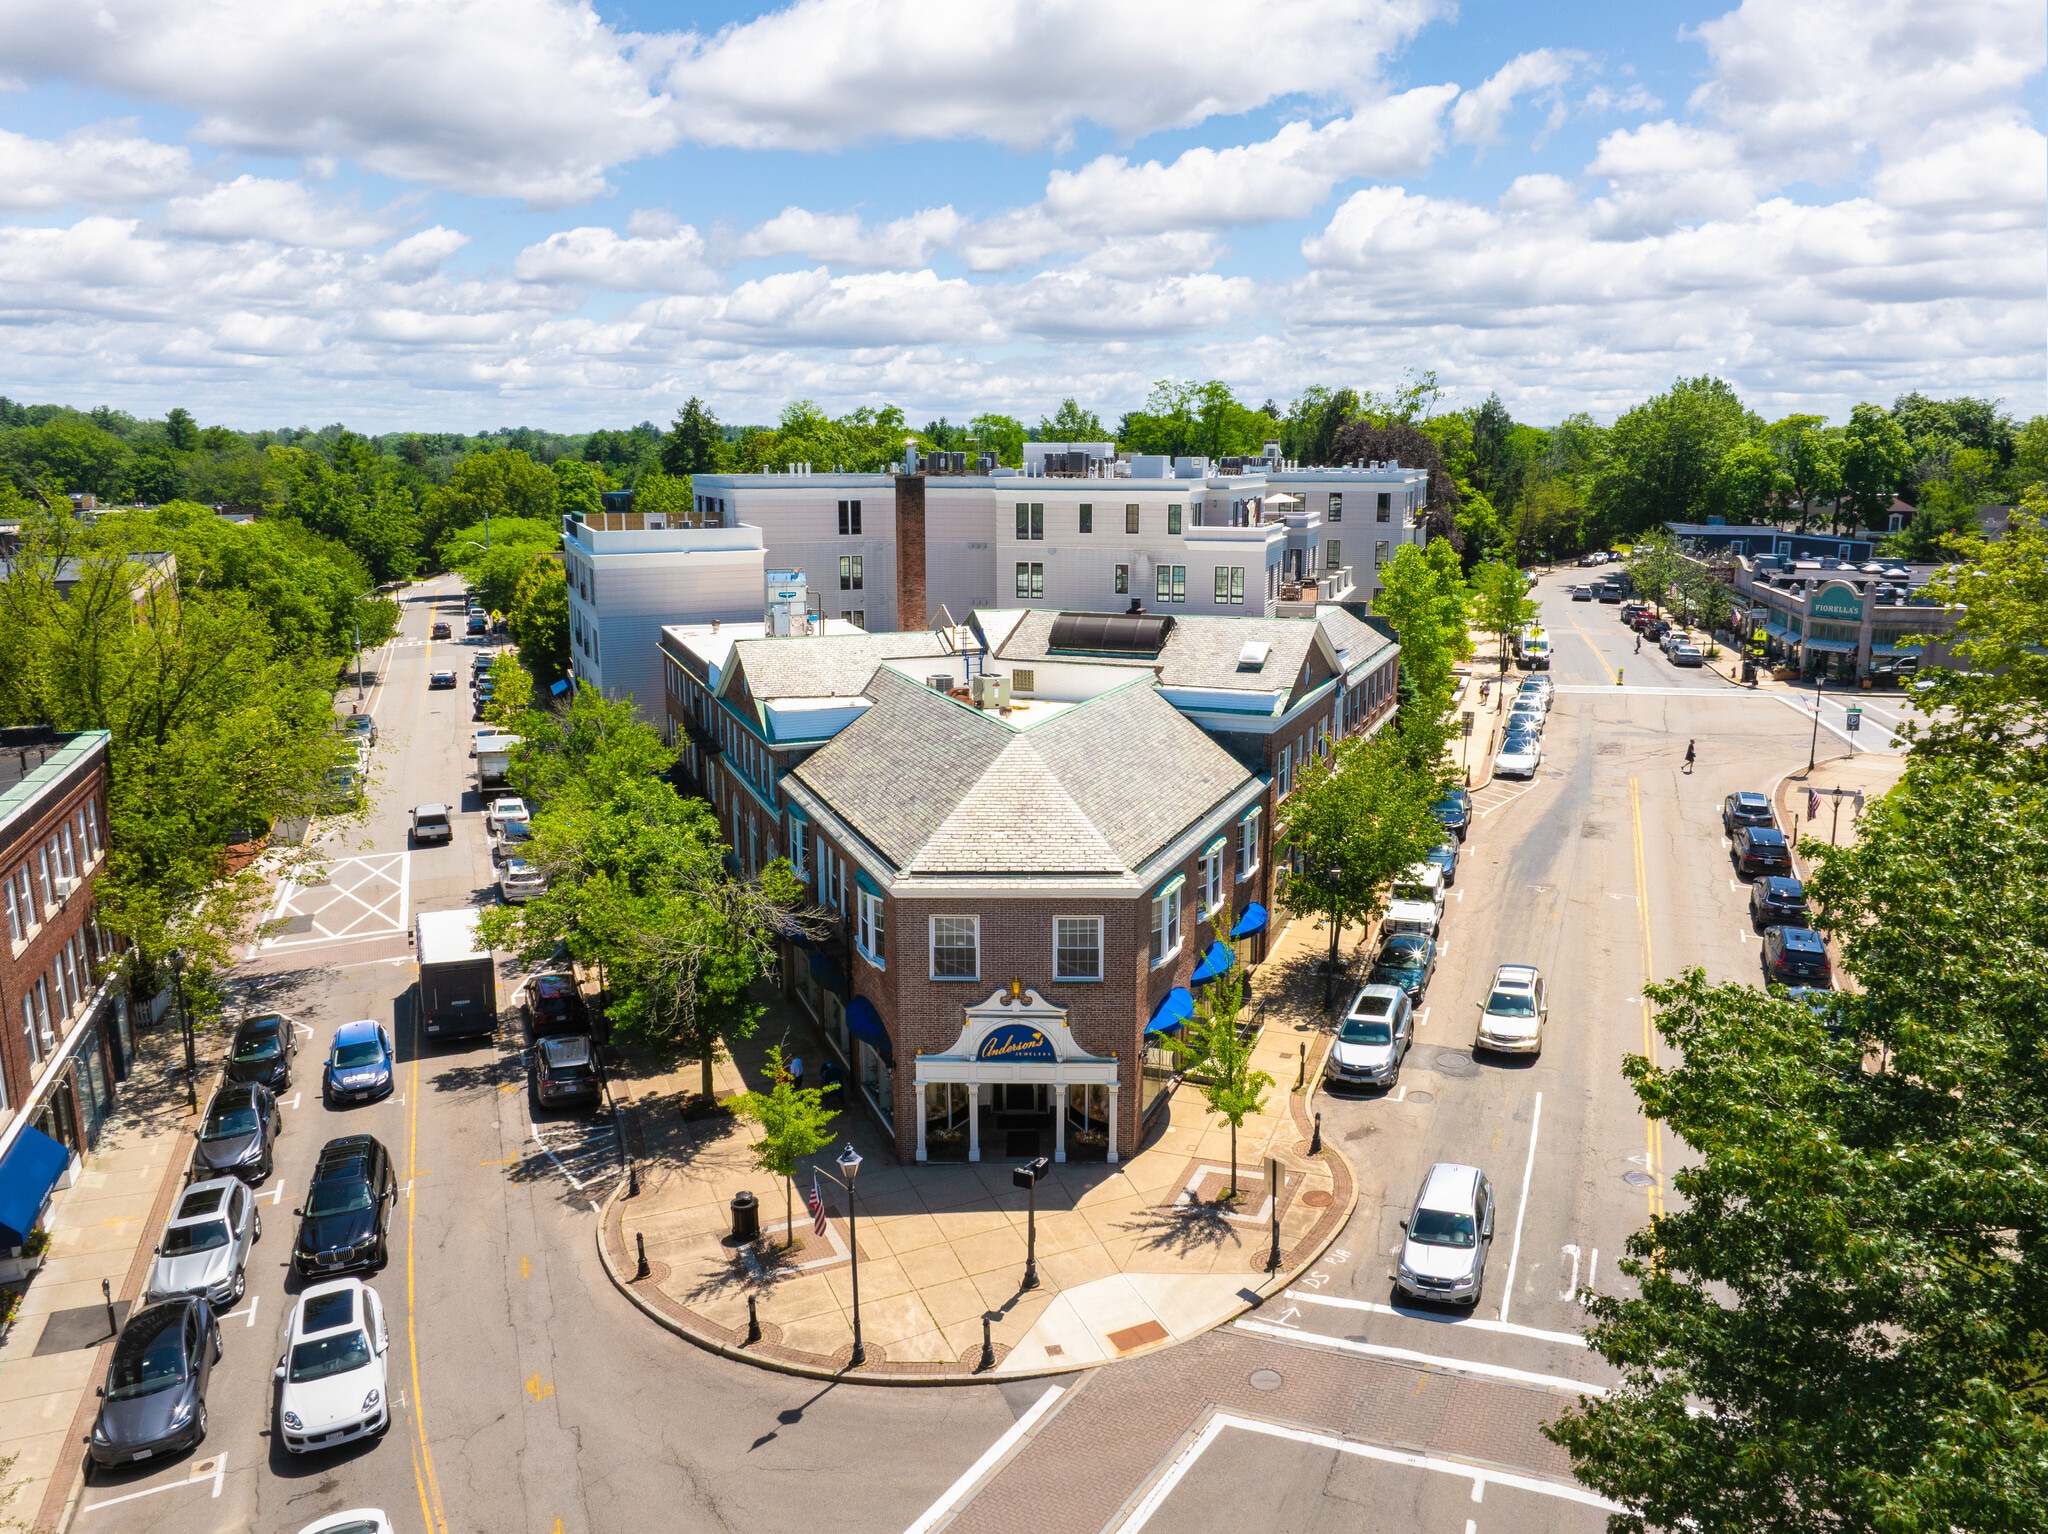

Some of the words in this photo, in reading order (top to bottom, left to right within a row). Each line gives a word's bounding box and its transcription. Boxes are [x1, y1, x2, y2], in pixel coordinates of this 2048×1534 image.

[1815, 605, 1859, 614] FIORELLA'S
[982, 1032, 1044, 1058] Anderson's
[1302, 1271, 1330, 1289] DS
